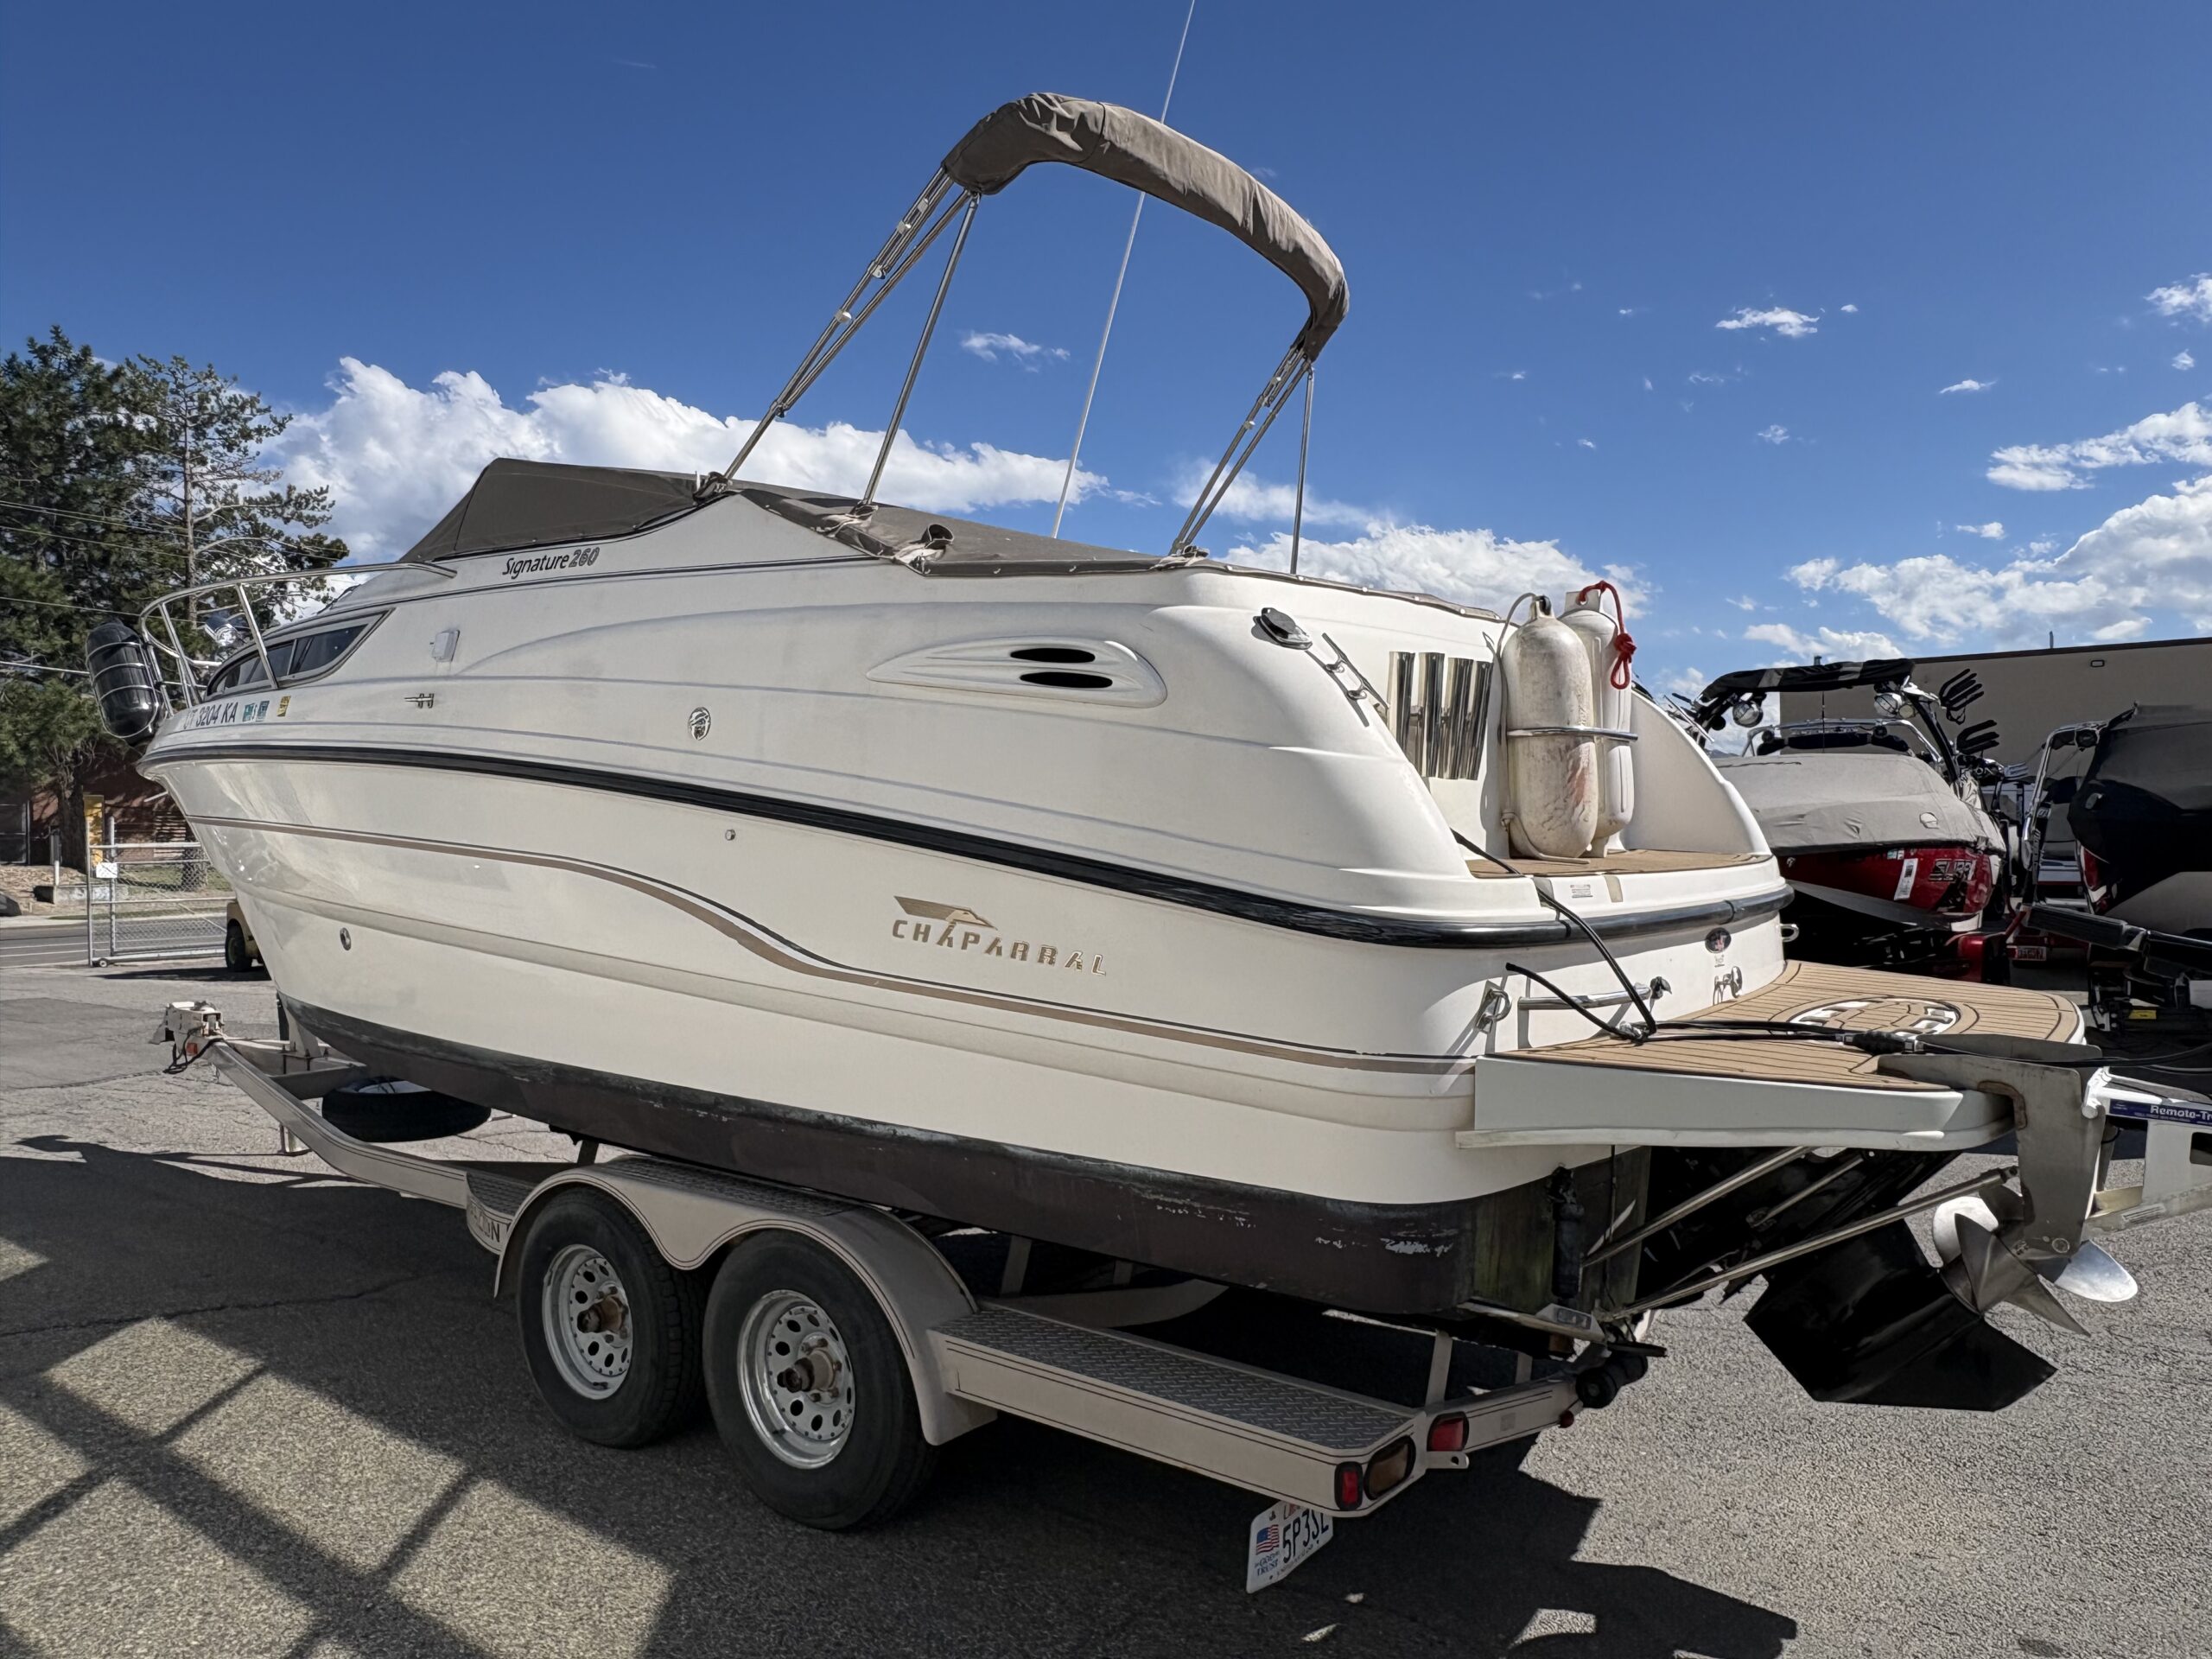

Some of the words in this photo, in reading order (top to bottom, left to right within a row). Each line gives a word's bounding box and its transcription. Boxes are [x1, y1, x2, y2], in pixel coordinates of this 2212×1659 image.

[502, 554, 569, 579] Signature
[569, 547, 601, 568] 260
[220, 702, 239, 723] KA
[892, 918, 1107, 976] CHAPARRAL
